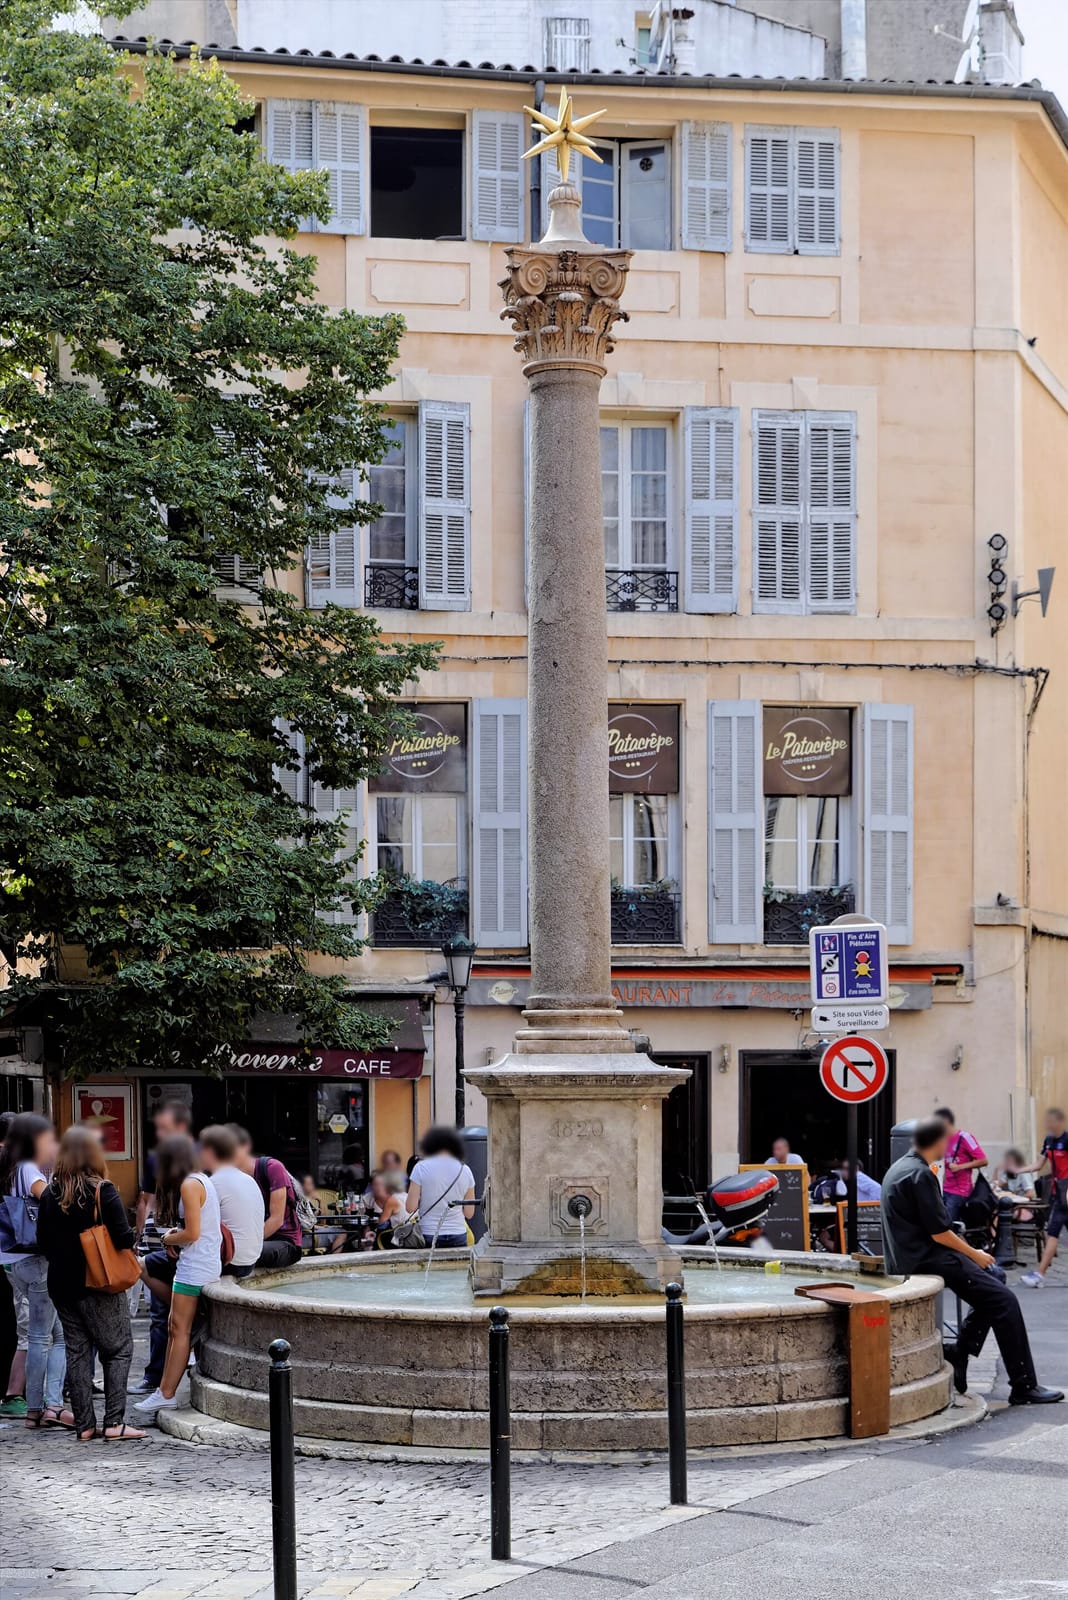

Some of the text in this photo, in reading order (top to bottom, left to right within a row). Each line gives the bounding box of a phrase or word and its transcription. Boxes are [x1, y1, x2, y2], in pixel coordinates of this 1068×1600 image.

[765, 731, 848, 760] Le Patacrêpe
[858, 932, 876, 940] d'Aire
[611, 985, 693, 1003] AURANT
[832, 1010, 845, 1018] Site
[863, 1009, 883, 1017] Vidéo
[837, 1019, 879, 1027] Surveillance
[343, 1058, 391, 1075] CAFE
[551, 1118, 604, 1137] 1820
